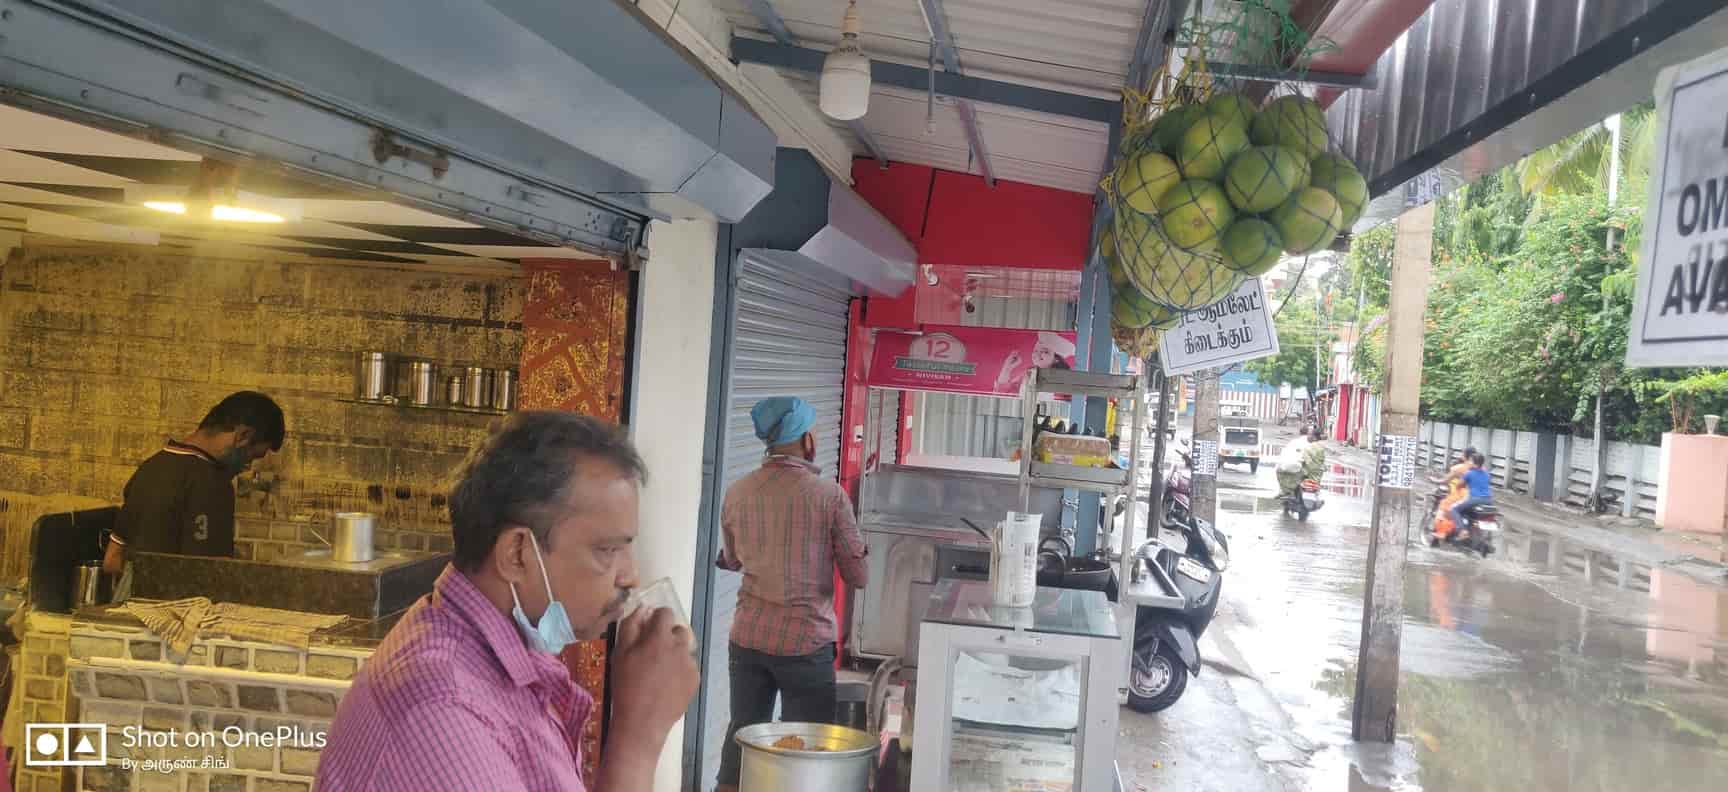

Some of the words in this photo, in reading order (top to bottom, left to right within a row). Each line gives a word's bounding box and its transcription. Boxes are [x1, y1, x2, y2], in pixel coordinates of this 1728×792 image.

[927, 338, 951, 358] 12
[1184, 318, 1254, 355] கிடைக்கும்
[194, 514, 208, 540] 3
